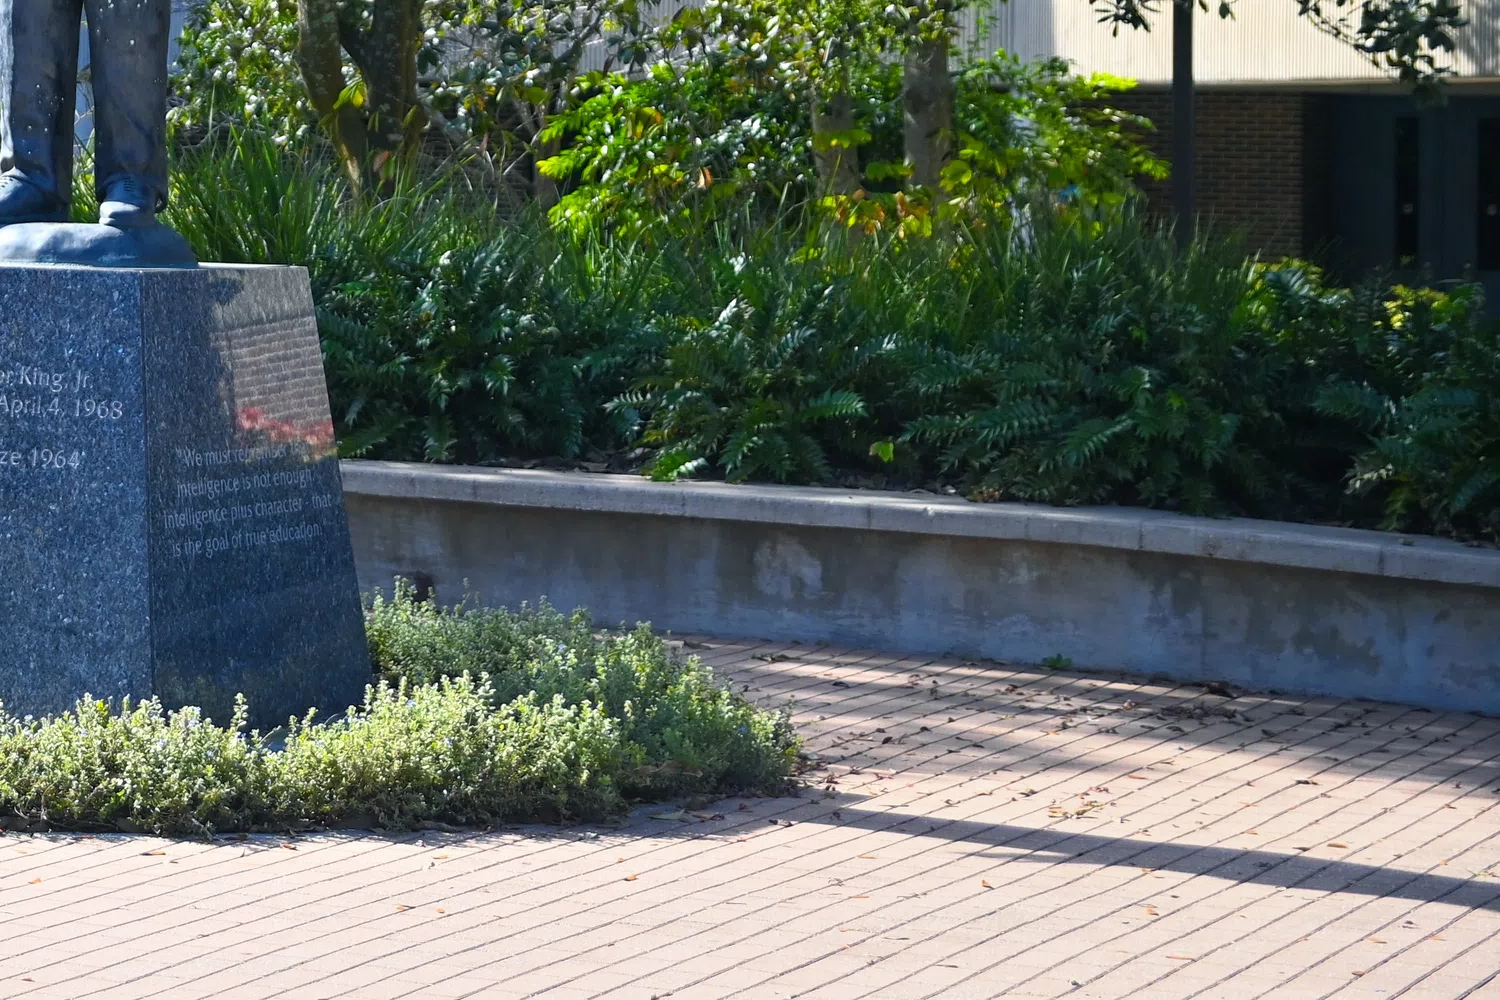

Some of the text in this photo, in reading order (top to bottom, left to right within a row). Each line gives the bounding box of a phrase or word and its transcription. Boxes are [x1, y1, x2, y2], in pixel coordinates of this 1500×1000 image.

[74, 369, 94, 392] Jr.
[74, 398, 123, 420] 1968
[31, 446, 81, 470] 1964
[205, 448, 232, 466] must
[176, 473, 240, 500] intelligence
[242, 475, 252, 490] is
[253, 470, 272, 488] not
[163, 506, 229, 530] Intelligence
[231, 500, 254, 525] plus
[255, 496, 303, 517] character
[311, 493, 332, 510] that
[172, 542, 182, 558] is
[184, 537, 203, 556] the
[205, 531, 230, 559] goal
[231, 528, 243, 549] of
[245, 529, 267, 550] true
